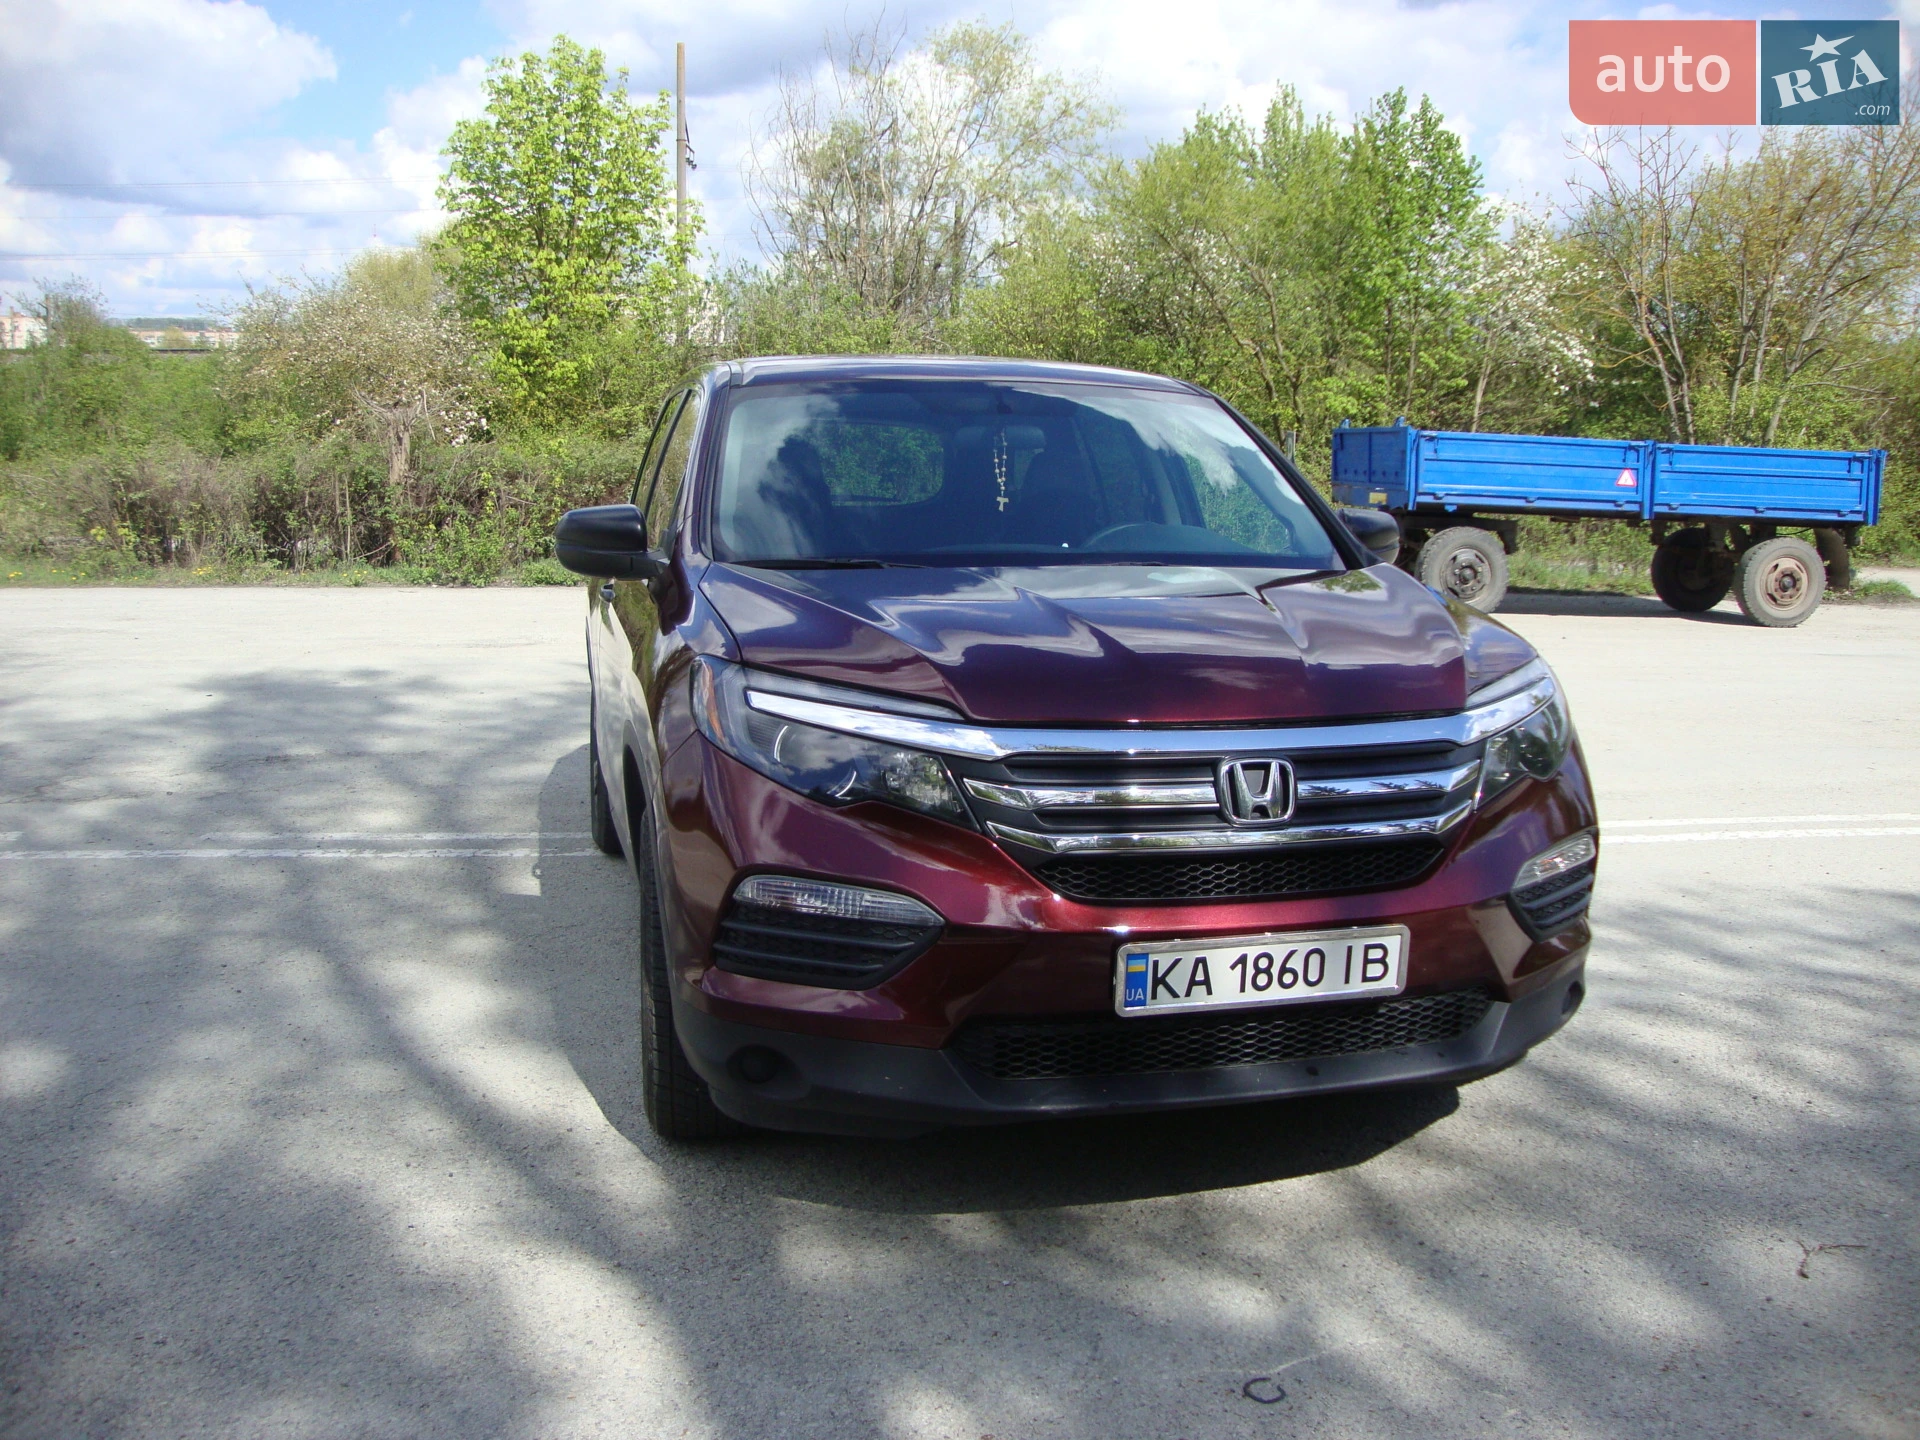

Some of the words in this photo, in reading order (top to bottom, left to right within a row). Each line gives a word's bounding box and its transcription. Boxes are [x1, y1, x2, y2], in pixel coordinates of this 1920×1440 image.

[1150, 957, 1213, 1001] KA
[1229, 947, 1326, 994] 1860
[1344, 942, 1389, 985] IB
[1126, 987, 1145, 1001] UA
